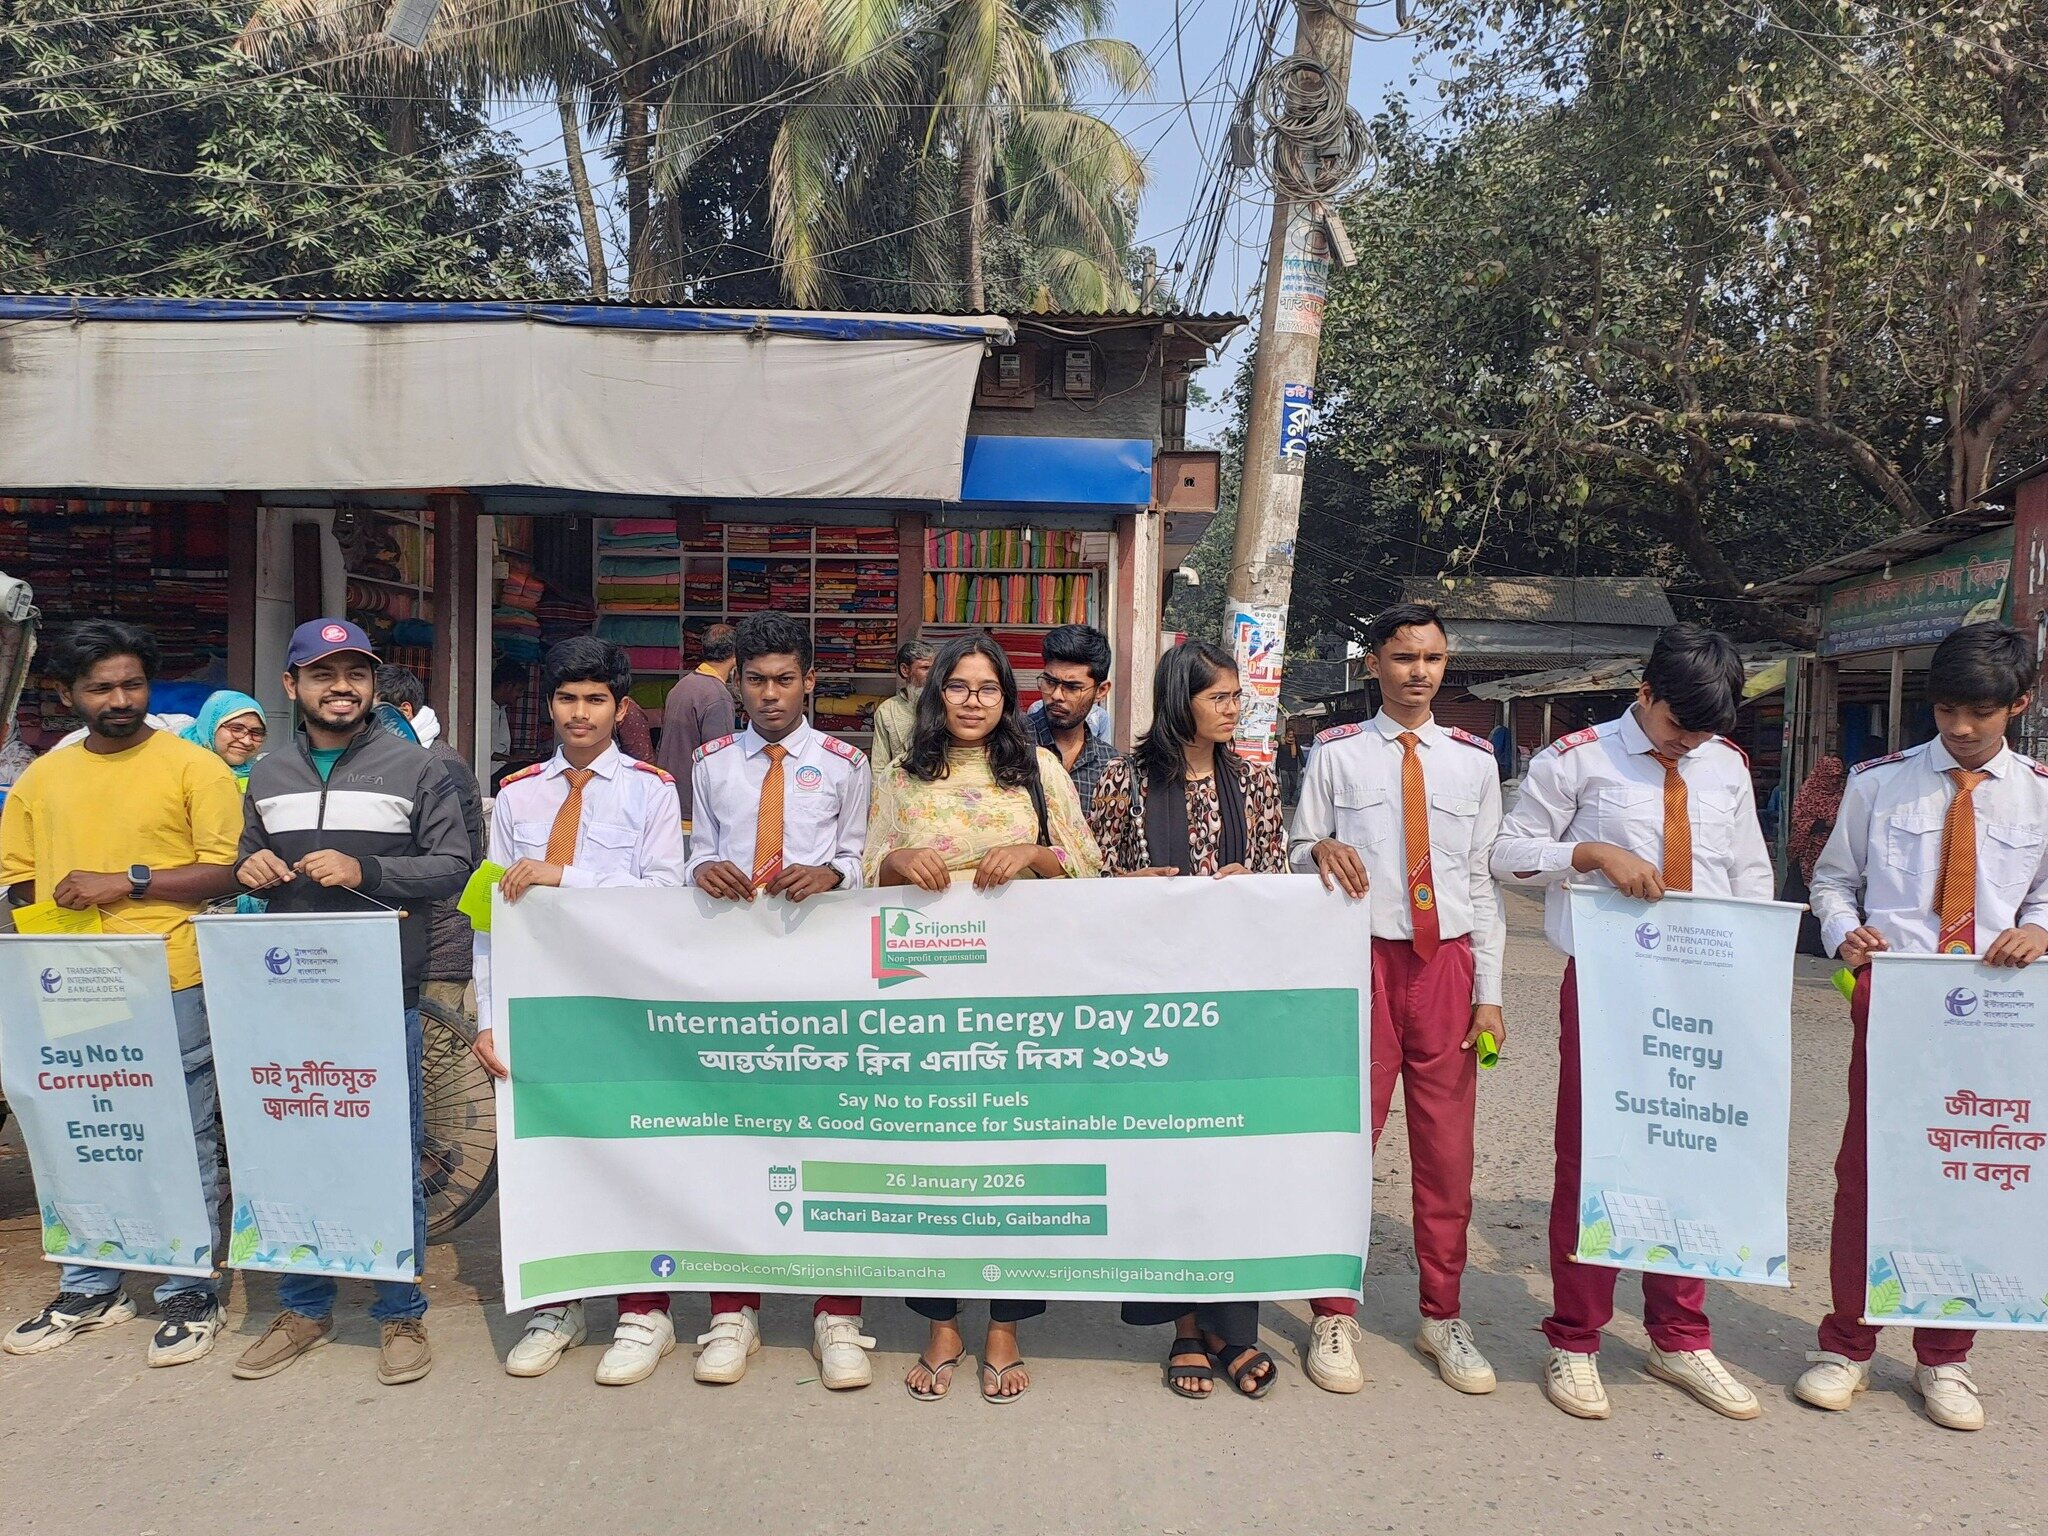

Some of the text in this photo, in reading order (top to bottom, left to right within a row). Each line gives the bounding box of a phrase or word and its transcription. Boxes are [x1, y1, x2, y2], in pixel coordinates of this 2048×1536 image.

[915, 920, 986, 937] Srijonshil
[1667, 924, 1734, 938] TRANSPARENCY
[886, 938, 986, 949] GAIBANDHA
[1666, 945, 1734, 958] BANGLADESH
[1667, 934, 1734, 948] INTERNATIONAL
[887, 952, 986, 963] Non-profit organisation
[66, 966, 123, 975] TRANSPARENCY
[66, 976, 125, 984] INTERNATIONAL
[67, 985, 126, 994] BANGLADESH
[647, 1001, 1220, 1037] International Clean Energy Day 2026
[1652, 1007, 1714, 1035] Clean
[41, 1045, 144, 1068] Say No to
[698, 1041, 1169, 1076] আন্তর্জাতিক ক্লিন এনার্জি দিবস ২০২৬
[1642, 1035, 1723, 1070] Energy
[38, 1070, 154, 1094] Corruption
[250, 1061, 378, 1094] চাই দুর্নীতিমুক্ত
[1668, 1067, 1696, 1090] for
[93, 1095, 113, 1113] in
[262, 1096, 371, 1122] জ্বালানি খাত
[838, 1091, 1029, 1111] Say No to Fossil Fuels
[1615, 1090, 1749, 1127] Sustainable
[1945, 1089, 2031, 1124] জীবাশ্ম
[67, 1120, 145, 1142] Energy
[630, 1113, 1245, 1133] Renewable Energy & Good Governance for Sustainable Development
[1647, 1124, 1718, 1153] Future
[1926, 1125, 2047, 1152] জ্বালানিকে
[76, 1144, 144, 1163] Sector
[885, 1173, 1026, 1191] 26 January 2026
[1942, 1161, 2031, 1191] না বলুন
[810, 1207, 1091, 1229] Kachari Bazar Press Club, Gaibandha
[680, 1258, 946, 1280] facebook.com/SrijonshilGaibandha
[1005, 1266, 1235, 1284] www.srijonshilgaibandha.org
